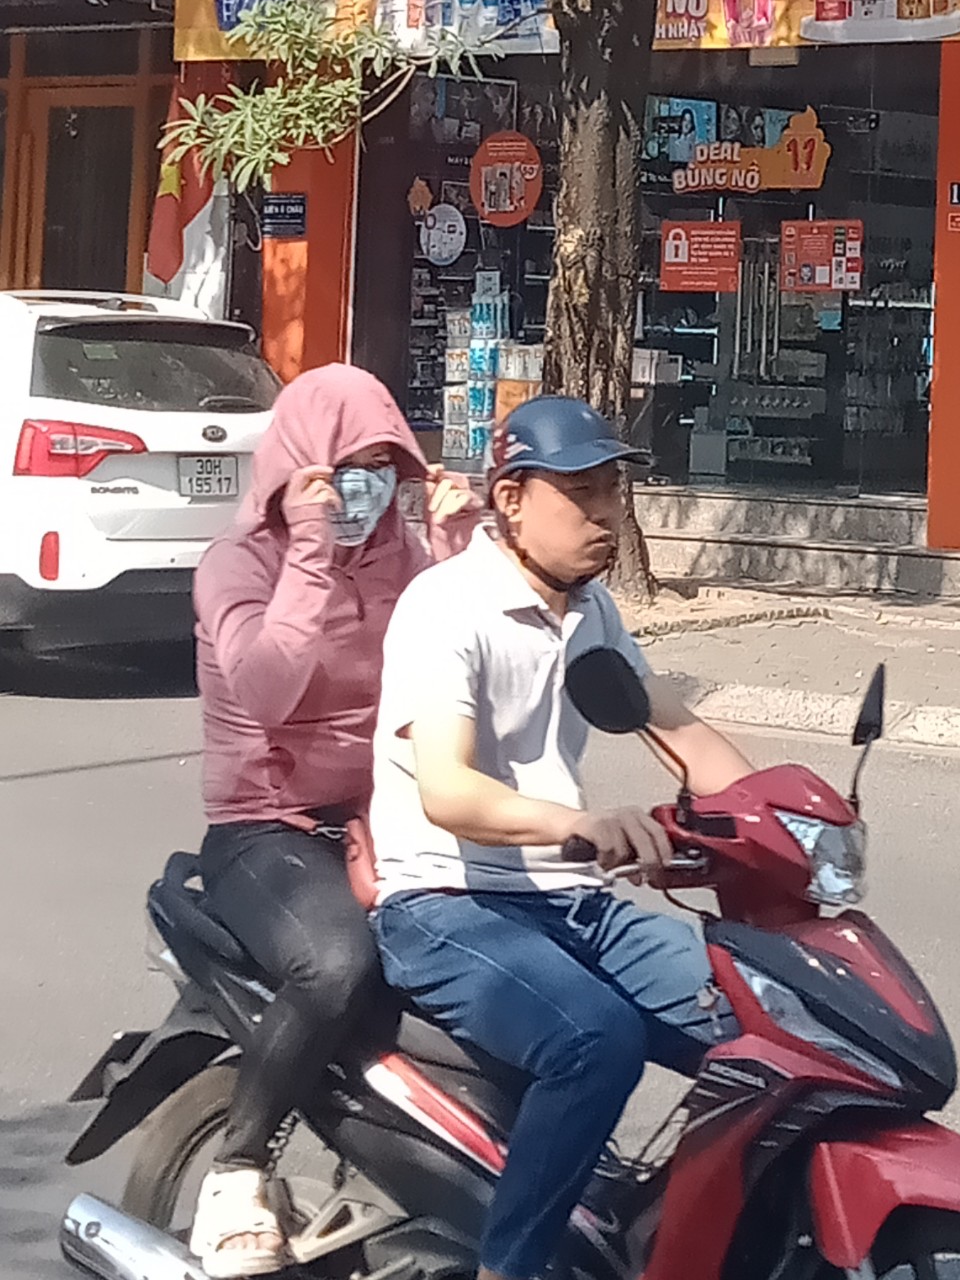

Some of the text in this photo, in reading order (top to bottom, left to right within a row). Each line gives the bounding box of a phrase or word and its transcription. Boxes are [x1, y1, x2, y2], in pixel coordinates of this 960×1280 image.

[696, 141, 742, 162] DEAL
[672, 163, 728, 190] BÙNG
[195, 458, 222, 475] 30H
